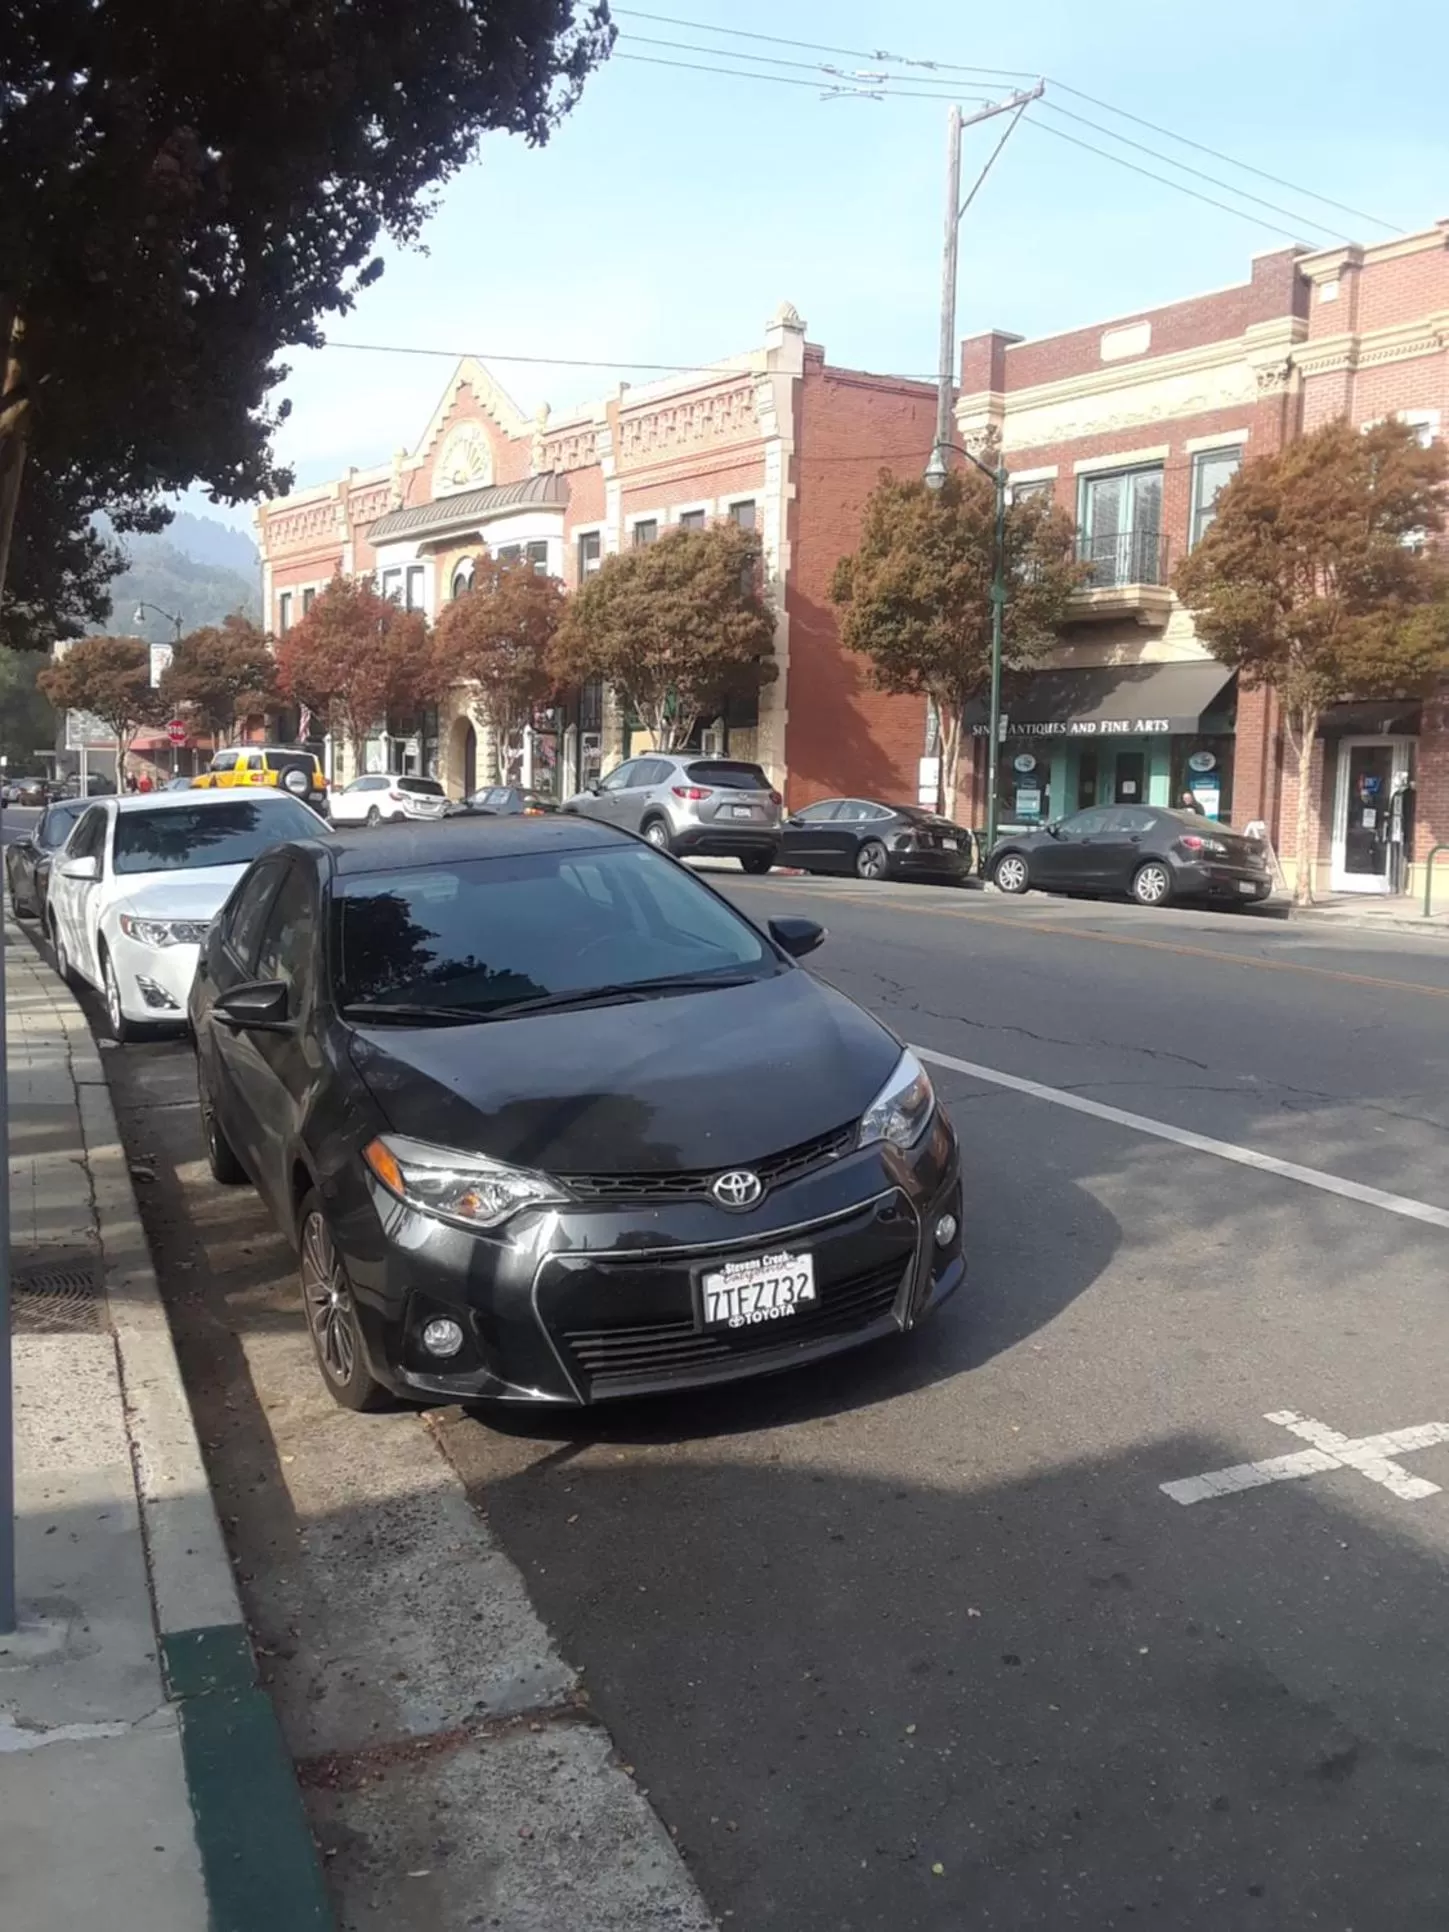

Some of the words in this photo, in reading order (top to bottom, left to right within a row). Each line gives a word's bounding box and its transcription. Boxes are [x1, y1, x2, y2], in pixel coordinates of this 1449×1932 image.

[1008, 722, 1067, 736] ANTIQUES
[1070, 722, 1097, 734] AND
[1100, 720, 1131, 733] FINE
[1134, 719, 1170, 732] ARTS
[744, 1303, 796, 1325] TOYOTA
